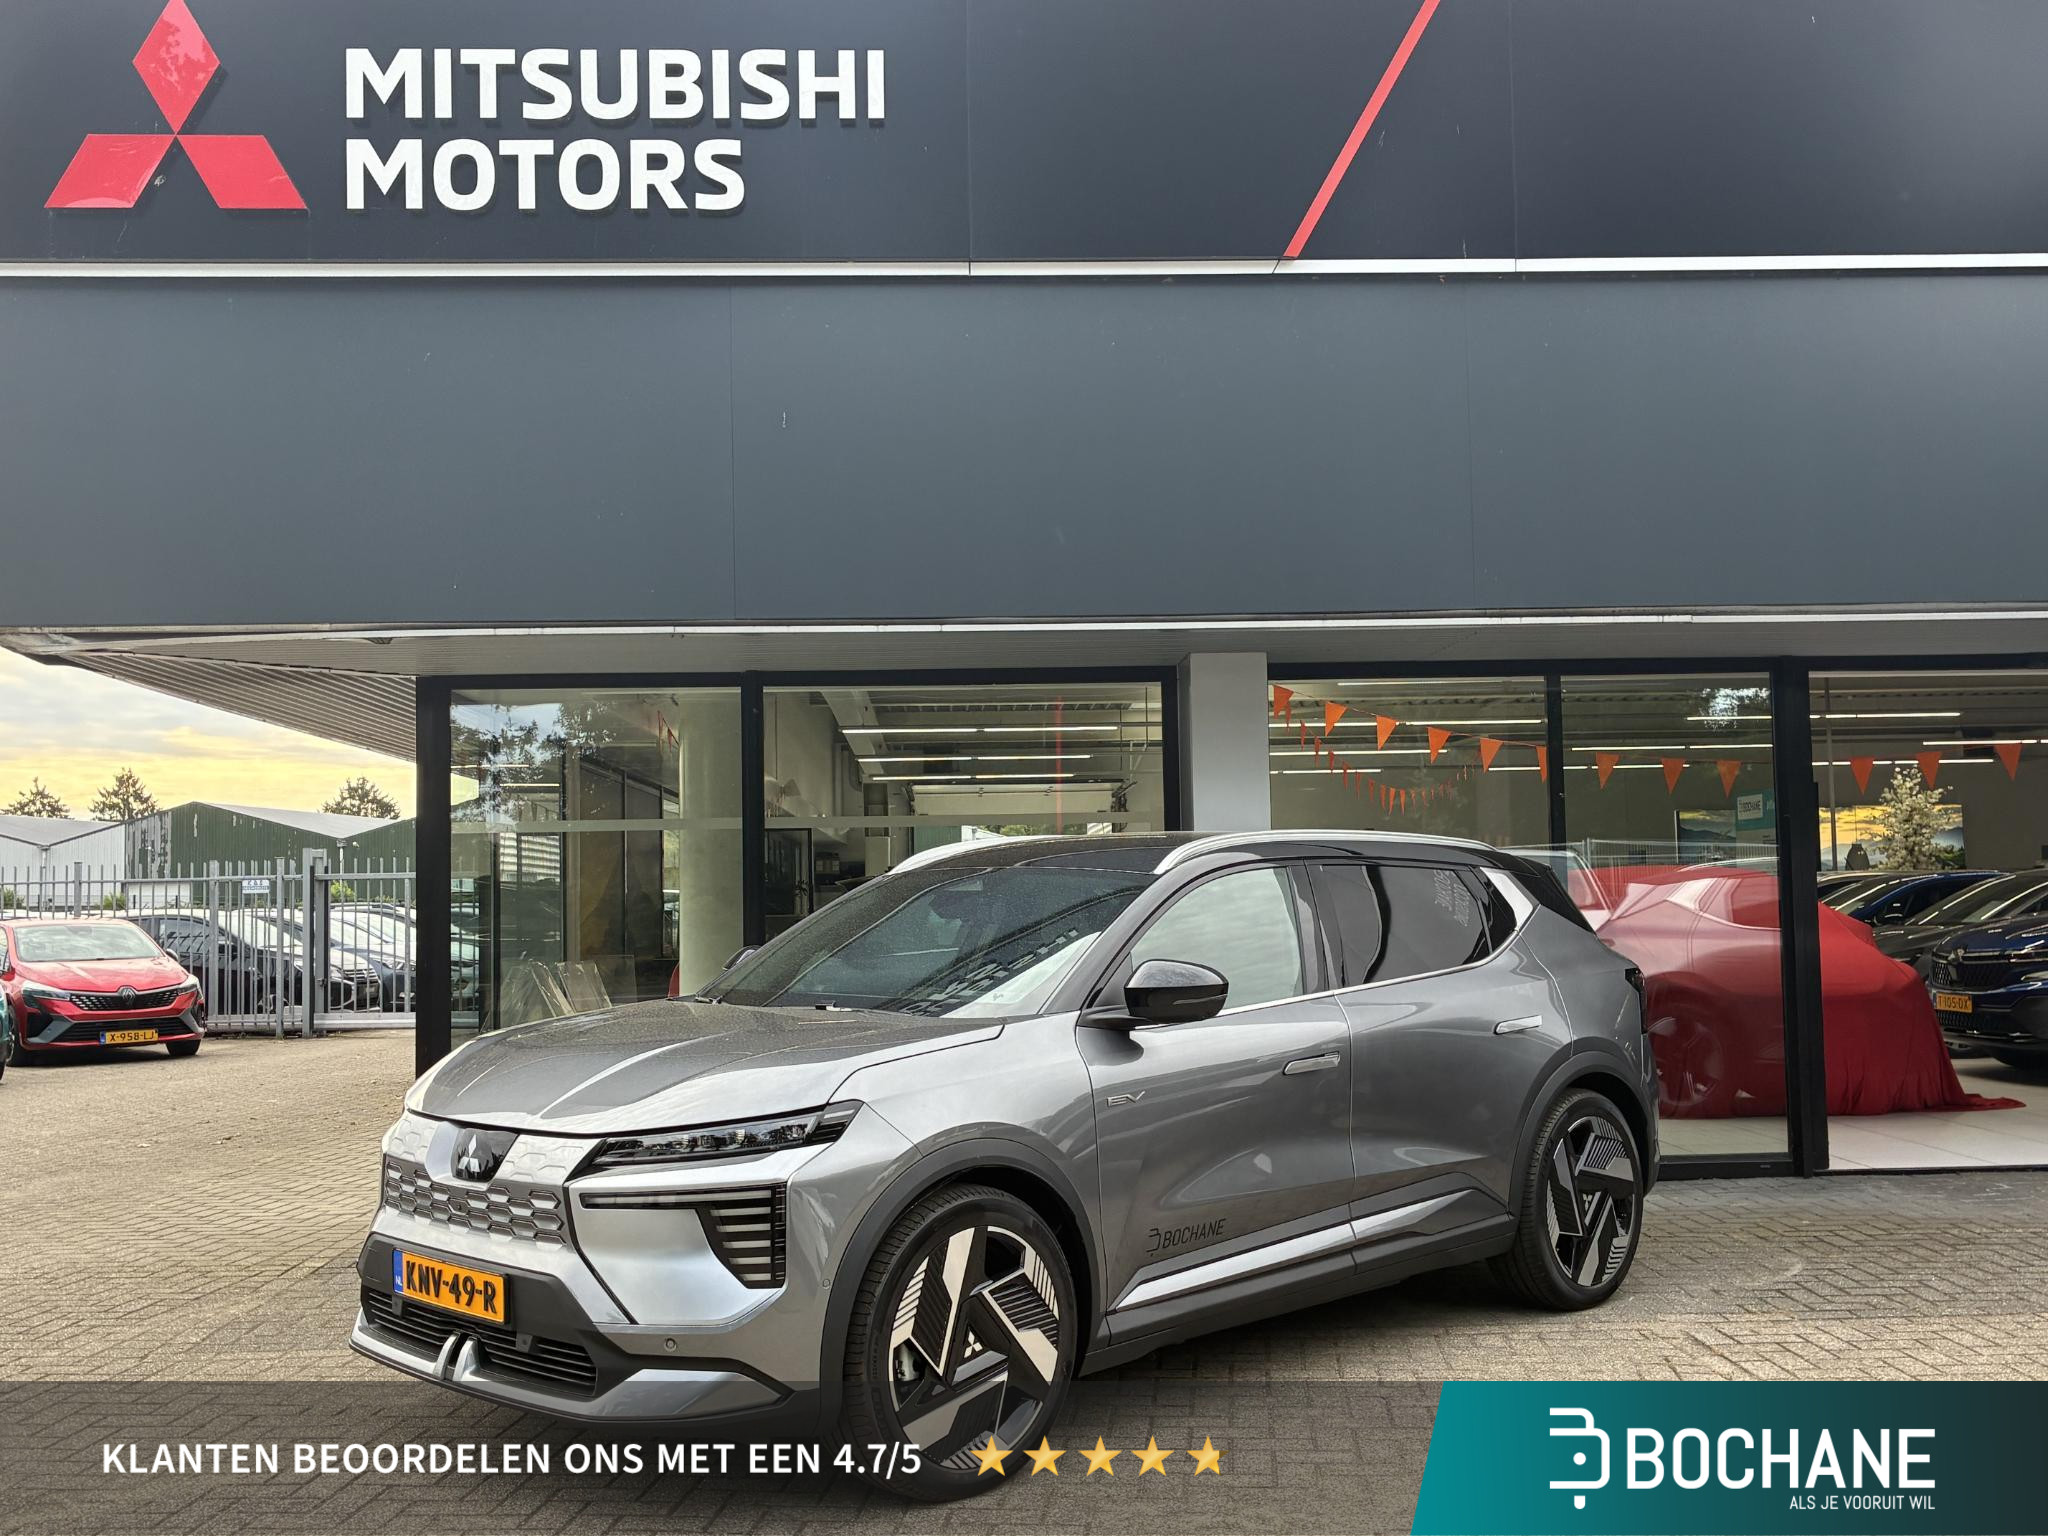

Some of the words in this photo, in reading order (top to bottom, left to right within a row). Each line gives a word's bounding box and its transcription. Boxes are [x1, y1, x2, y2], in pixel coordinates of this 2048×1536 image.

[345, 47, 886, 121] MITSUBISHI
[346, 138, 746, 211] MOTORS
[1162, 1218, 1227, 1249] BOCHANE
[406, 1260, 497, 1314] KNV-49-R
